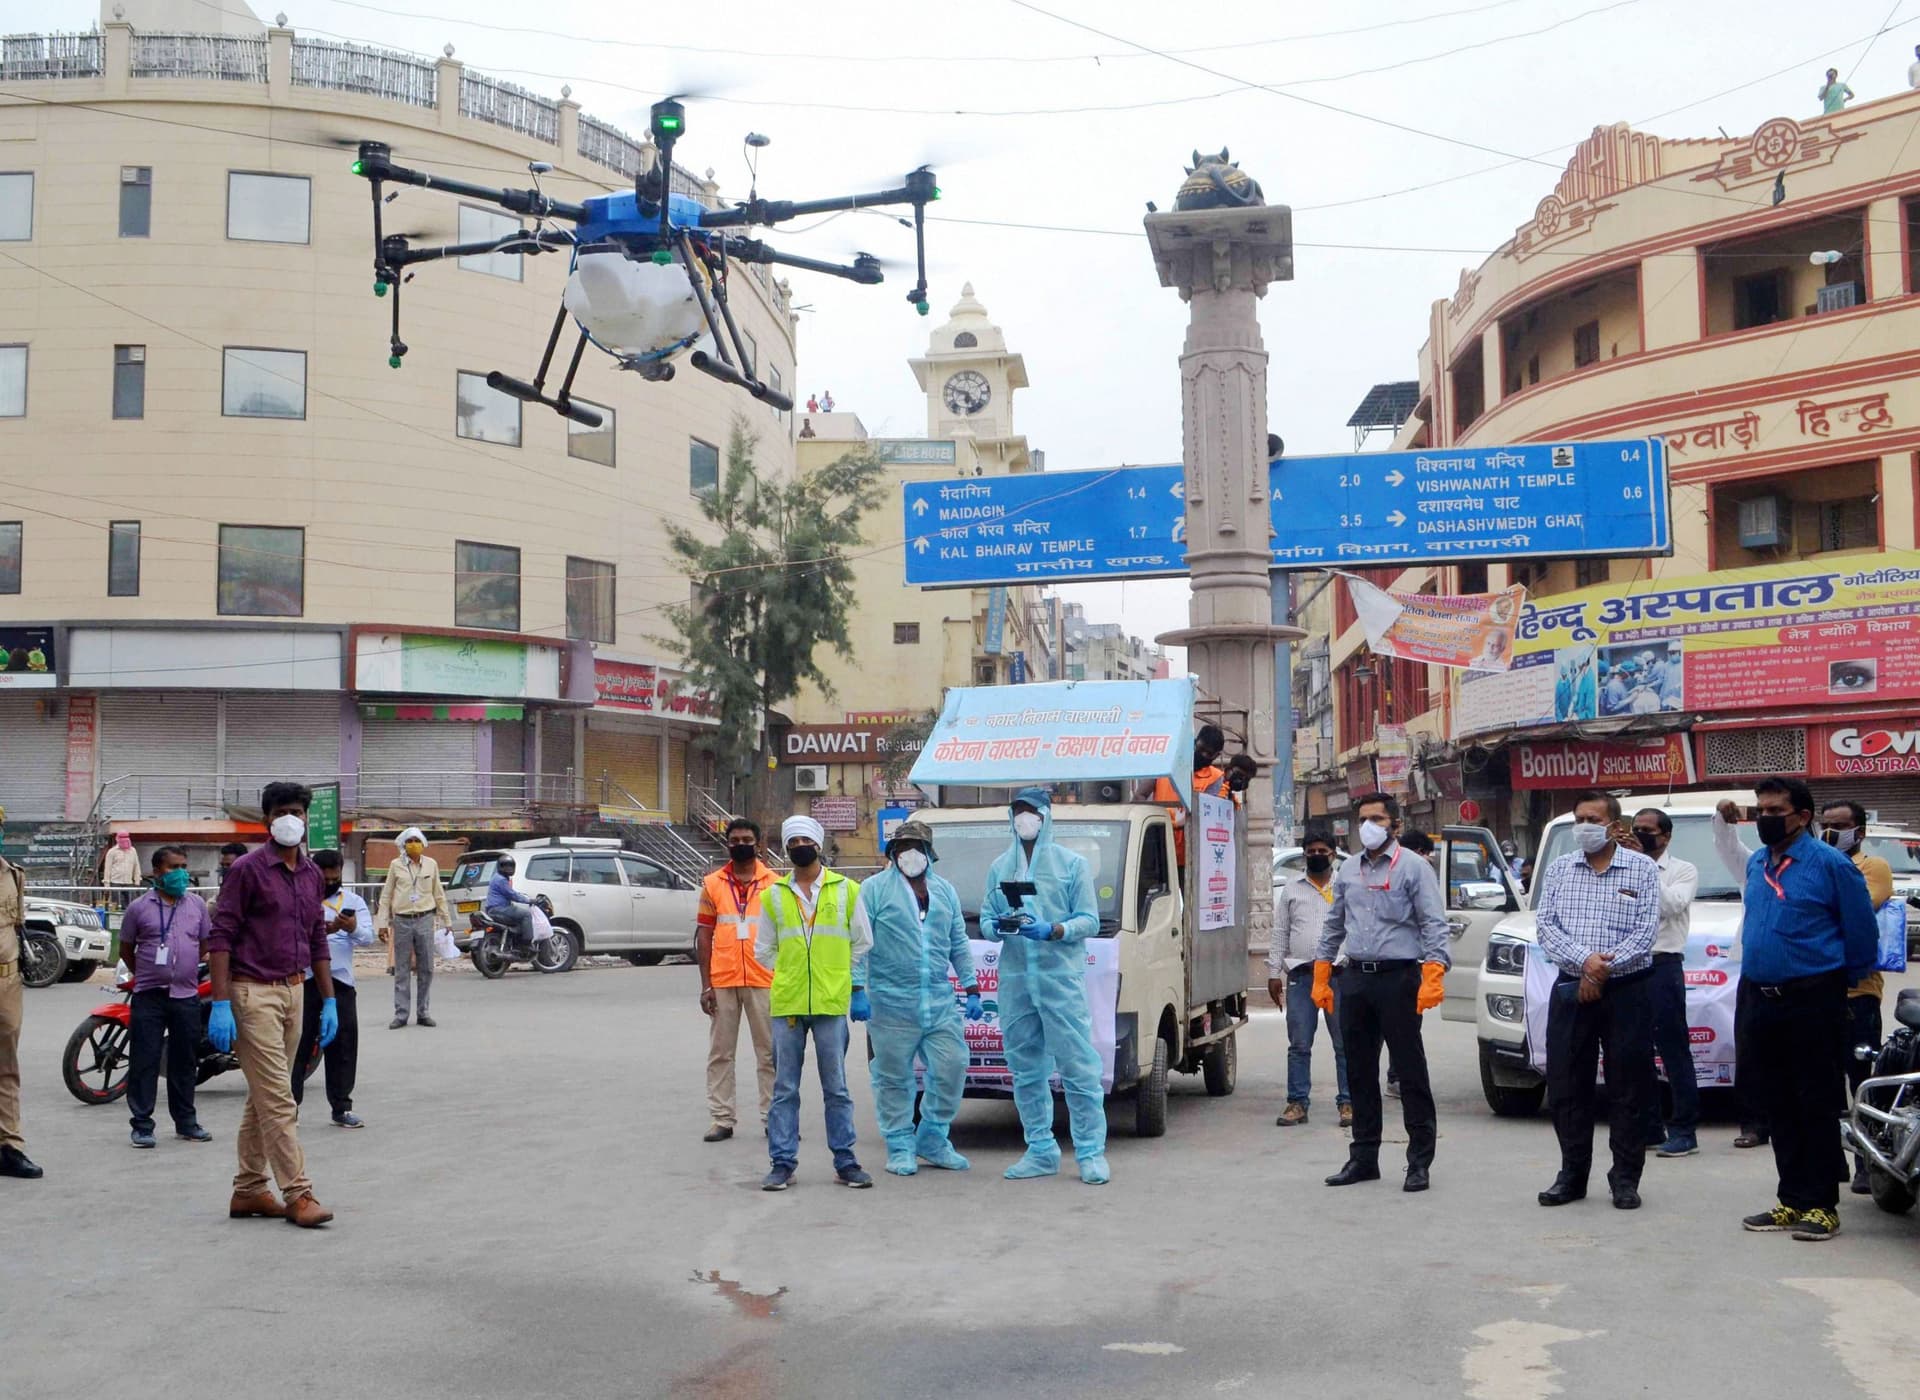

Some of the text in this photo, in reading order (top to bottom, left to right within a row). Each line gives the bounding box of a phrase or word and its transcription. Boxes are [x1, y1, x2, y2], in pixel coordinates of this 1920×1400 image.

[1665, 411, 1760, 452] रवाड़ी
[1416, 451, 1526, 474] विश्वनाथ मन्दिर
[1621, 449, 1640, 463] 0.4
[1340, 474, 1361, 487] 2.0
[1416, 473, 1576, 493] VISHWANATH TEMPLE
[940, 485, 990, 500] मैदागिन
[1128, 487, 1147, 499] 1.4
[1623, 487, 1642, 500] 0.6
[939, 504, 1006, 521] MAIDAGIN
[1417, 494, 1520, 513] दशाश्वमेध घाट
[940, 519, 1050, 541] काल भैरव मन्दिर
[1340, 515, 1362, 527] 3.5
[1417, 516, 1537, 534] DASHASHVMEDH
[1129, 526, 1147, 539] 1.7
[940, 539, 1095, 560] KAL BHAIRAV TEMPLE
[1425, 534, 1531, 551] वाराणसी
[1016, 557, 1093, 573] प्रान्तीय
[1598, 574, 1840, 624] अस्पताल
[1788, 620, 1910, 640] नेत्र ज्योति विभाग
[985, 705, 1122, 727] नगर निगम वाराणसी
[787, 732, 926, 754] DAWAT Retau
[988, 736, 1041, 761] वायरस
[1055, 734, 1098, 758] लक्षण
[1101, 727, 1131, 758] एवं
[1128, 733, 1170, 756] बचाव
[1520, 744, 1600, 784] Bombay
[1602, 756, 1632, 775] SHOE
[1634, 753, 1667, 773] MART
[1836, 756, 1920, 773] VASTRA
[1686, 971, 1720, 984] TEAM
